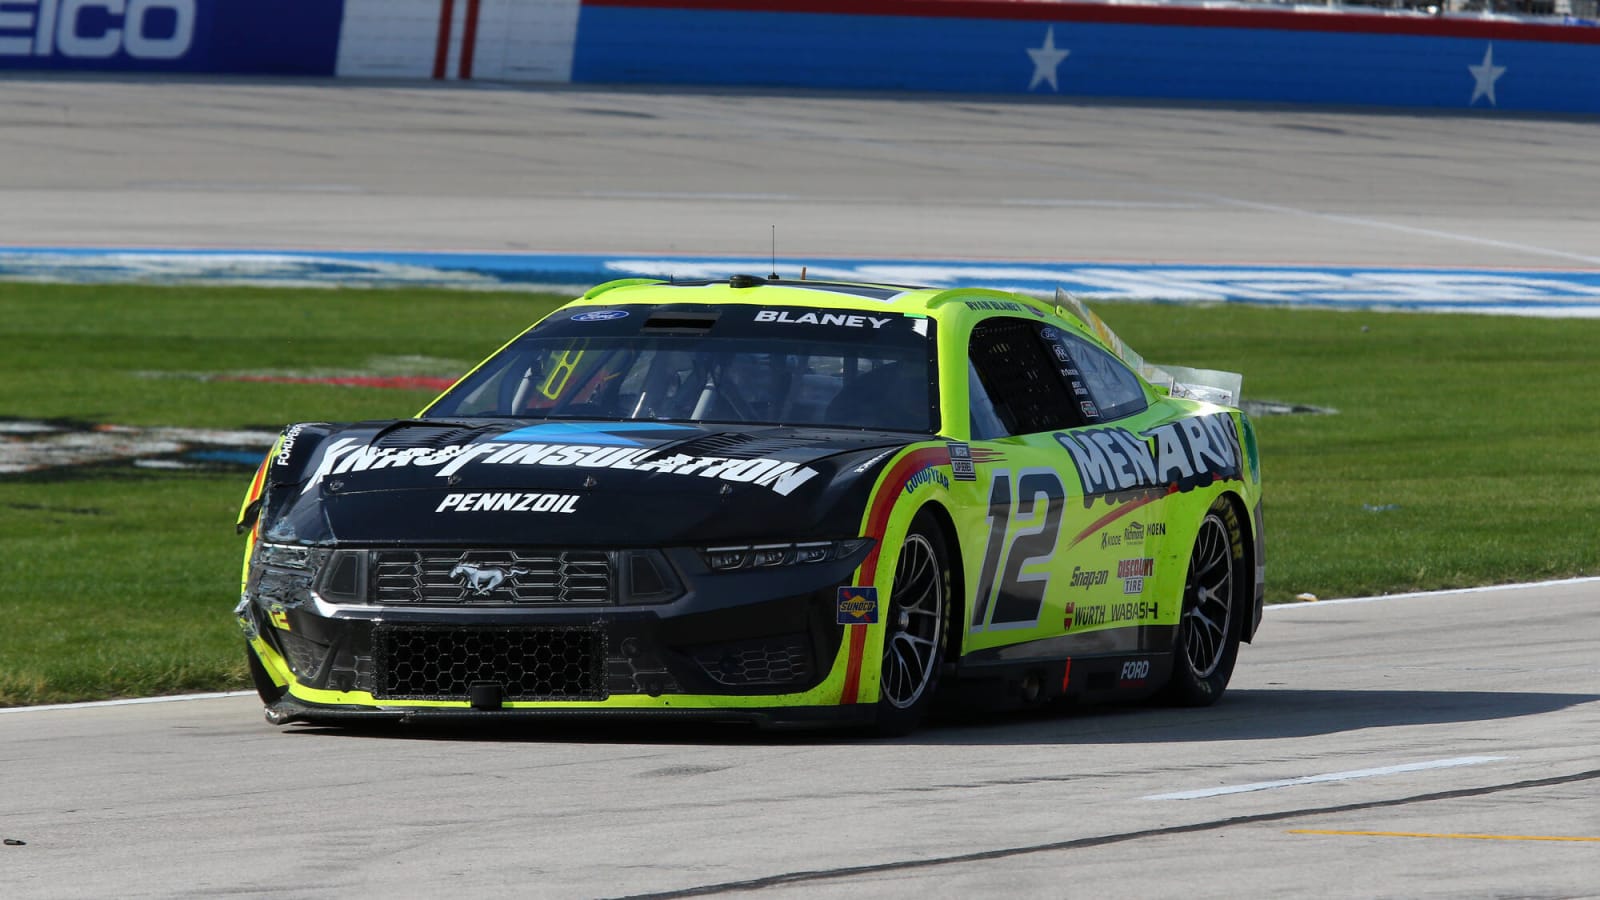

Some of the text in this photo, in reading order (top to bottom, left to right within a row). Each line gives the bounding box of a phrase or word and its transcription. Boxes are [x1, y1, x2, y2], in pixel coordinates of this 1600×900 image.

[754, 310, 892, 329] BLANEY
[904, 464, 950, 494] GOODYEAR
[435, 492, 580, 514] PENNZOIL
[1147, 523, 1166, 537] MOEN
[970, 467, 1067, 635] 12
[1069, 566, 1109, 590] Snap-on
[1117, 558, 1154, 578] DISCOUNT
[1124, 580, 1143, 592] TIRE
[839, 601, 875, 612] SUNOCO
[1111, 601, 1158, 621] WABASH
[1120, 661, 1150, 679] FORD
